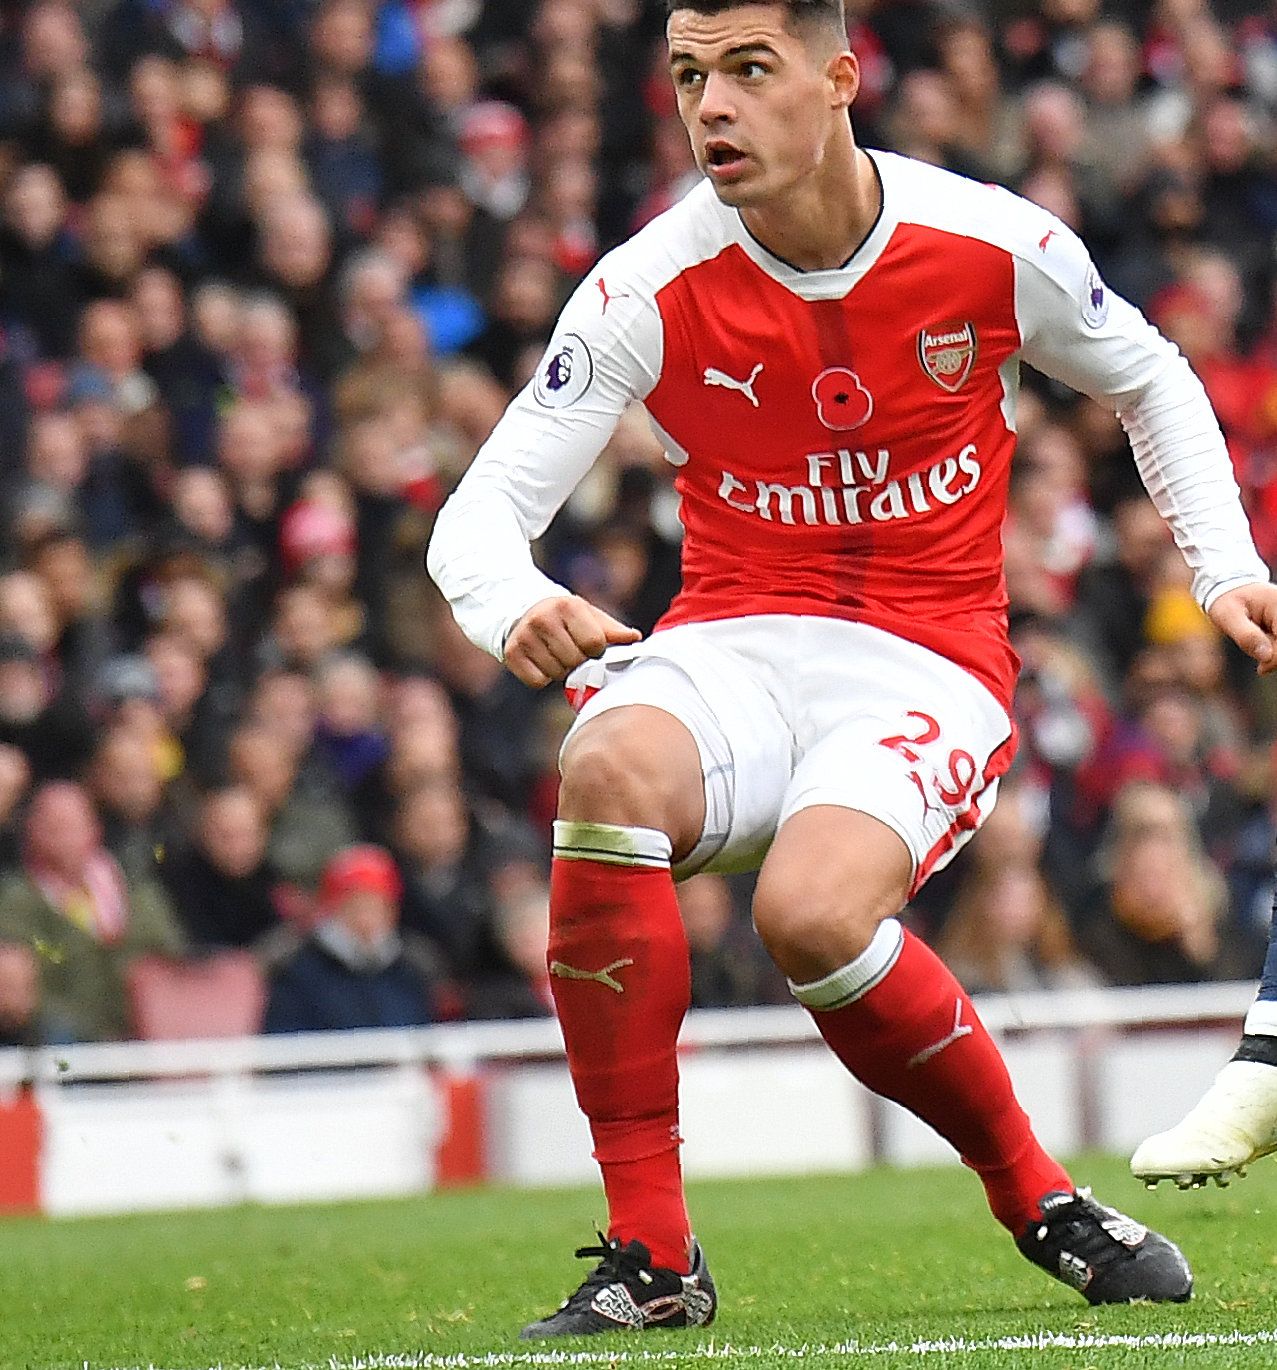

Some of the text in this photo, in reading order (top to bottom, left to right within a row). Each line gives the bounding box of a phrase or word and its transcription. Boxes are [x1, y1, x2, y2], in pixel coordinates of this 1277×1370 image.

[925, 329, 968, 348] Arsenal
[717, 442, 982, 526] Emirates
[805, 448, 890, 487] Fly
[878, 710, 977, 807] 29
